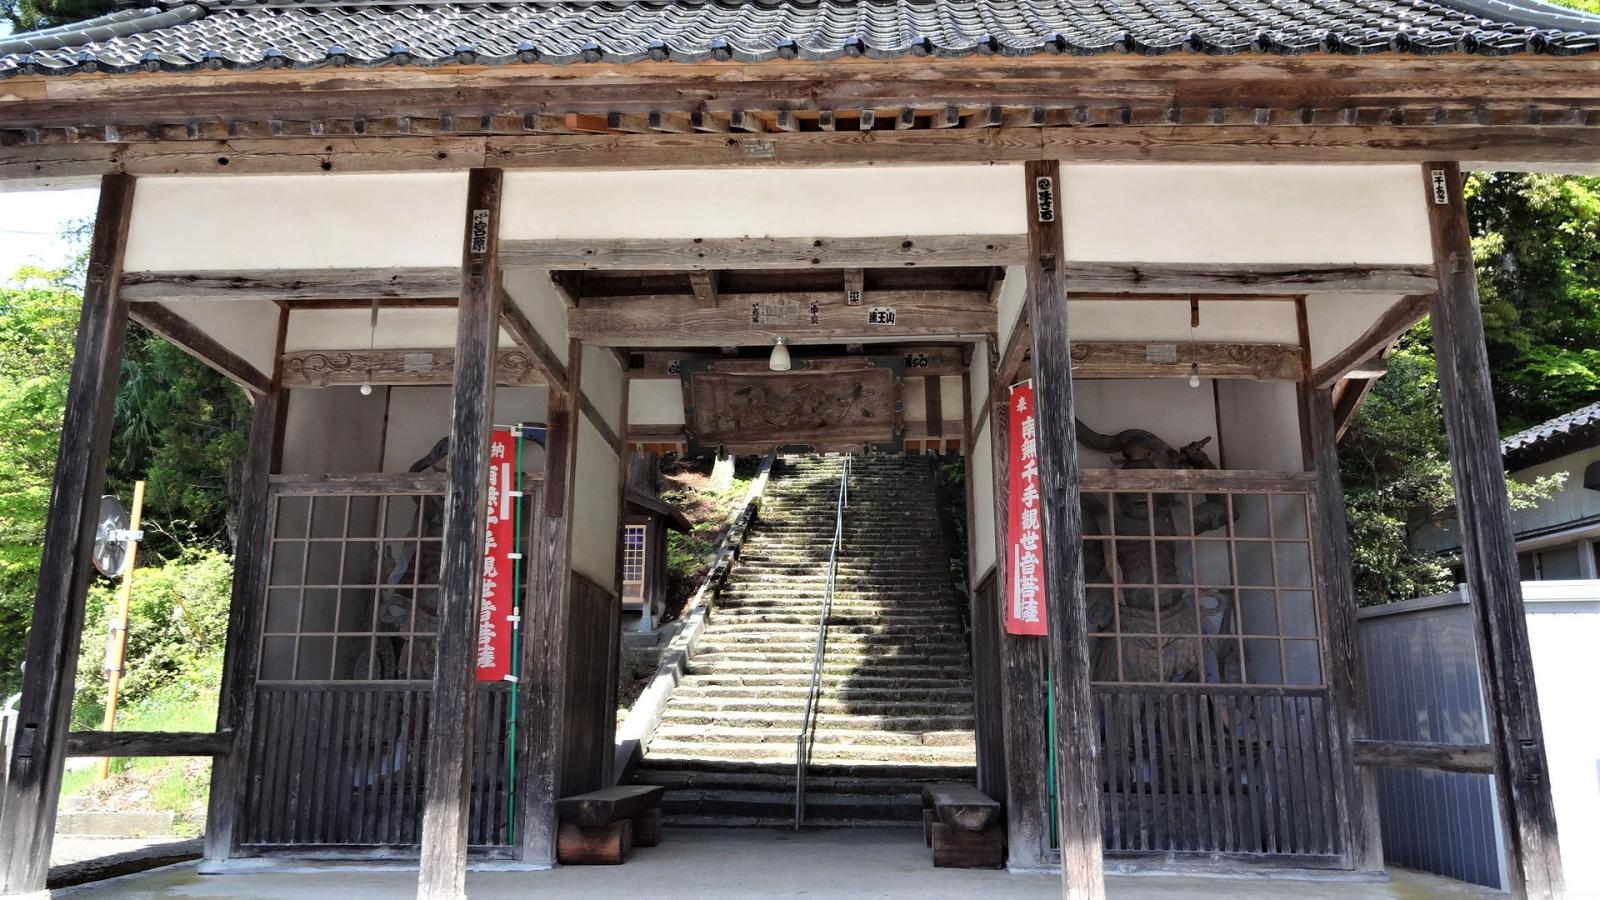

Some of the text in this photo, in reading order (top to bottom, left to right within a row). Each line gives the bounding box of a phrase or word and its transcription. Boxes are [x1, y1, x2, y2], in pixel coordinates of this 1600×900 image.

[491, 441, 505, 459] 納
[1020, 416, 1041, 623] 南無千手観世音菩薩
